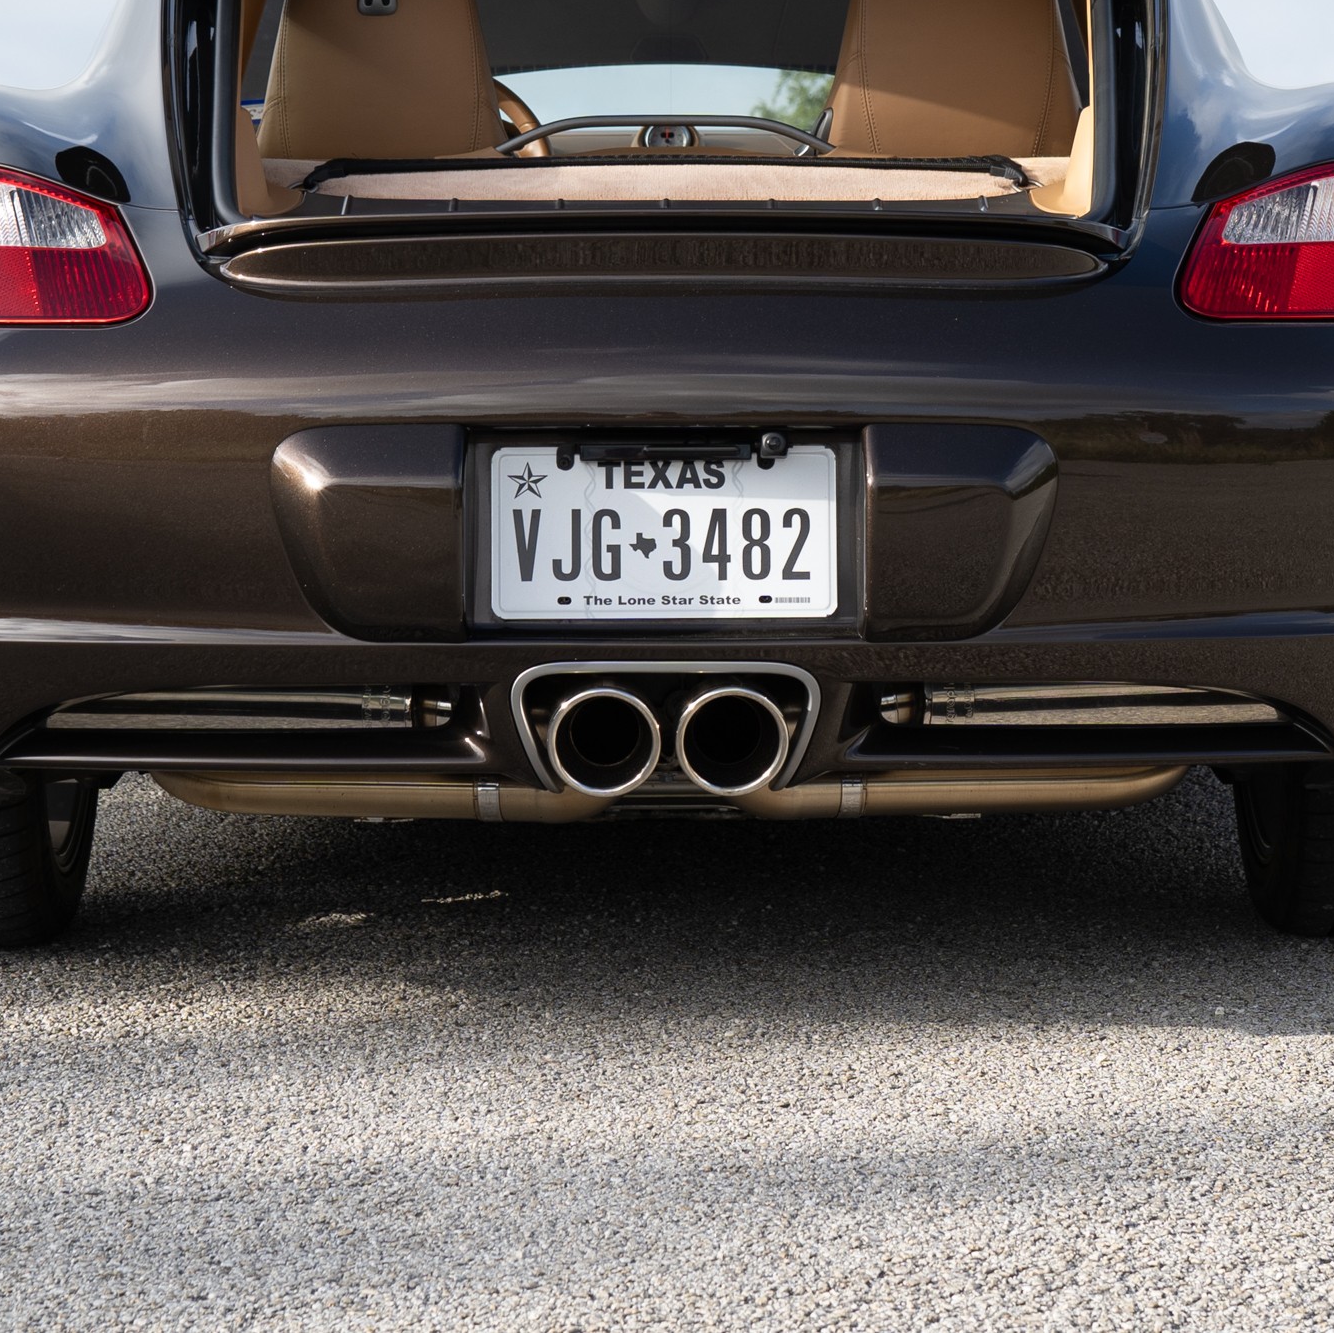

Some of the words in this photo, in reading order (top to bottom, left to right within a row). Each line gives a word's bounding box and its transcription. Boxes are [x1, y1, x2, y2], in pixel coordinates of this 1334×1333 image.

[598, 461, 725, 489] TEXAS
[513, 509, 621, 581] VJG
[663, 508, 811, 581] 3482
[584, 594, 612, 606] The
[619, 594, 655, 606] Lone
[662, 594, 694, 606] Star
[700, 594, 741, 606] State
